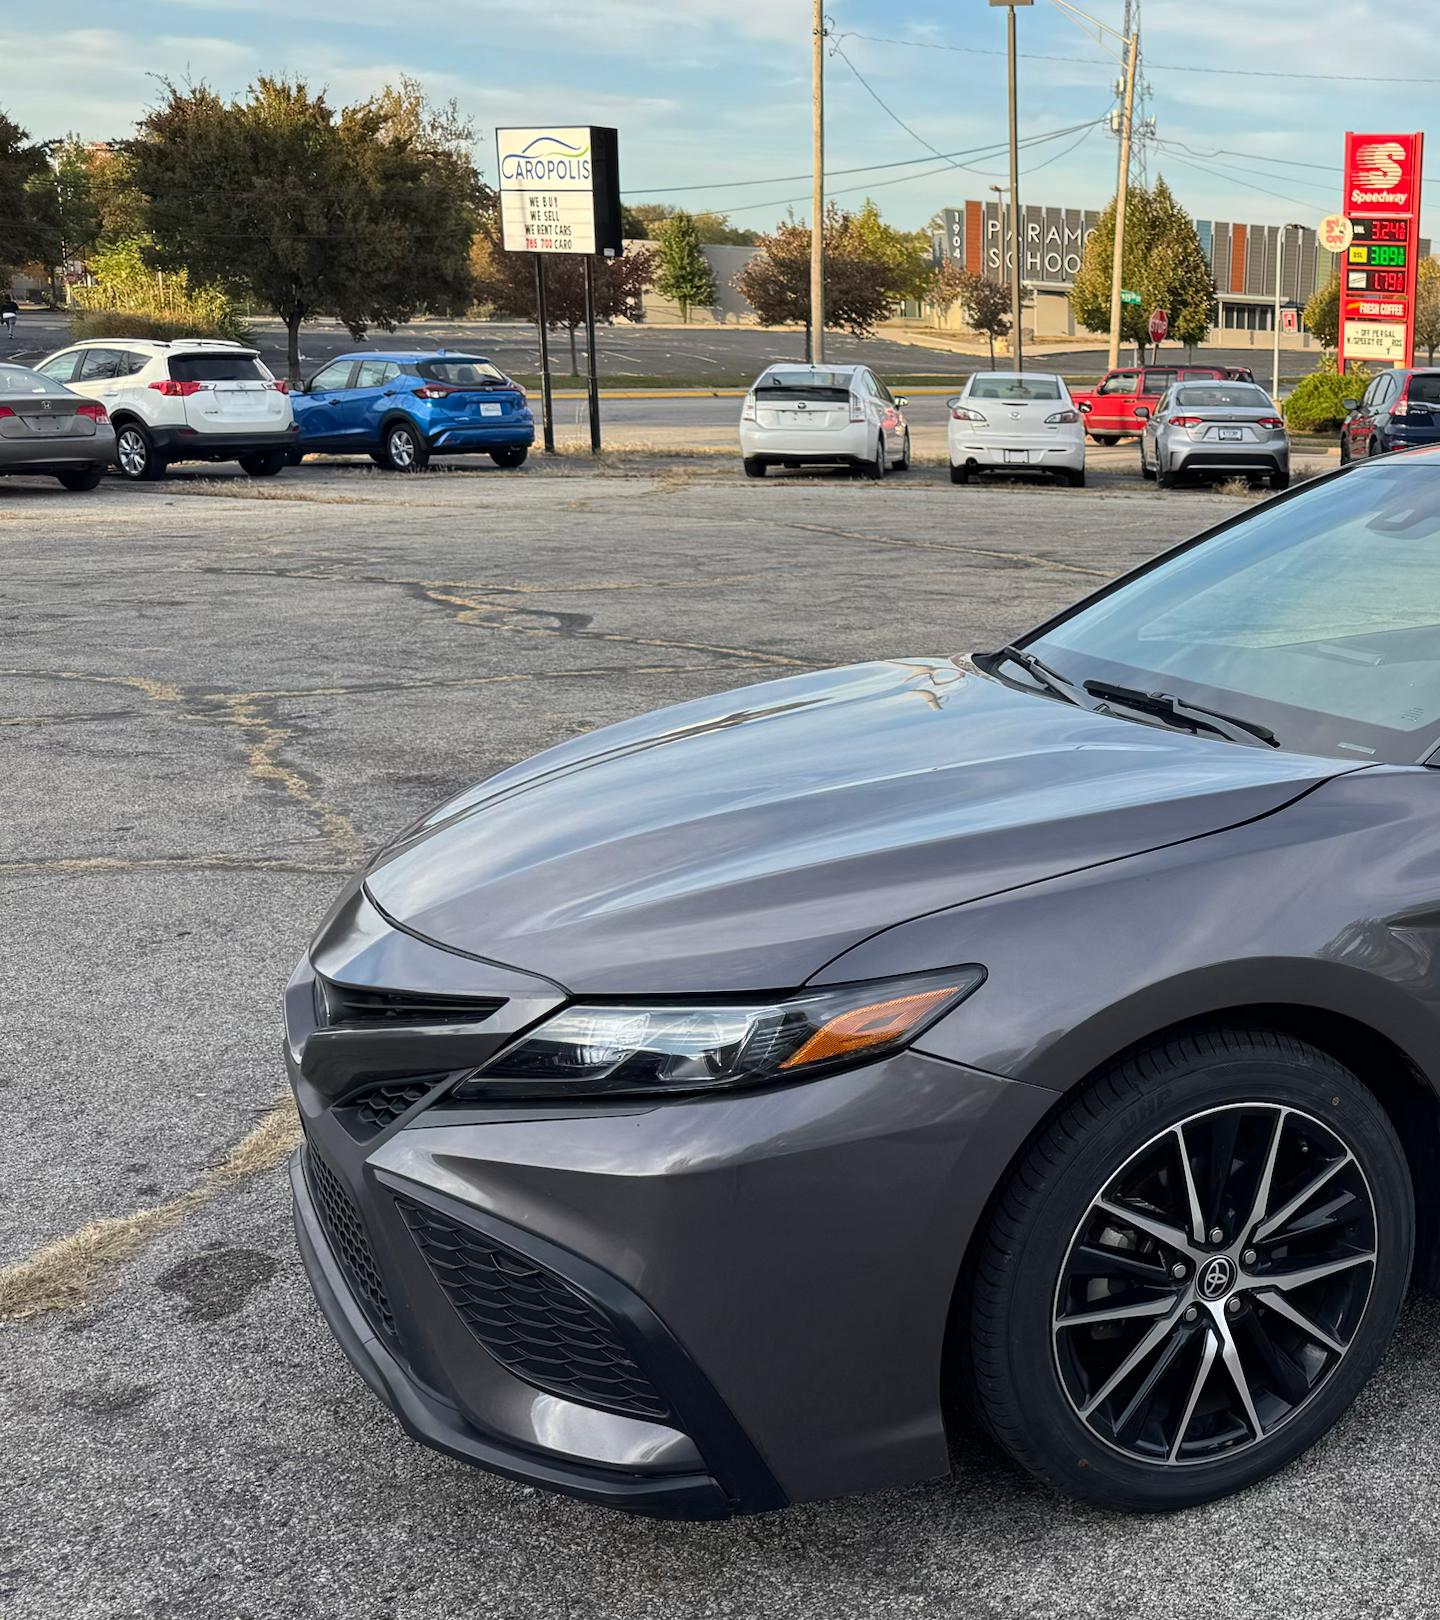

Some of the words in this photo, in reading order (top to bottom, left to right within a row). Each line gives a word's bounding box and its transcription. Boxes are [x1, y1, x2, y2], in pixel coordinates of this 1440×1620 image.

[502, 156, 591, 179] CAROPOLIS
[529, 196, 539, 207] WE
[542, 196, 558, 207] BUY
[1351, 189, 1408, 205] Speedway
[530, 210, 541, 221] WE
[544, 210, 560, 221] SELL
[525, 224, 535, 235] WE
[537, 224, 553, 235] RENT
[555, 224, 572, 236] CARS
[952, 212, 961, 259] 1904
[1150, 319, 1168, 333] STOP
